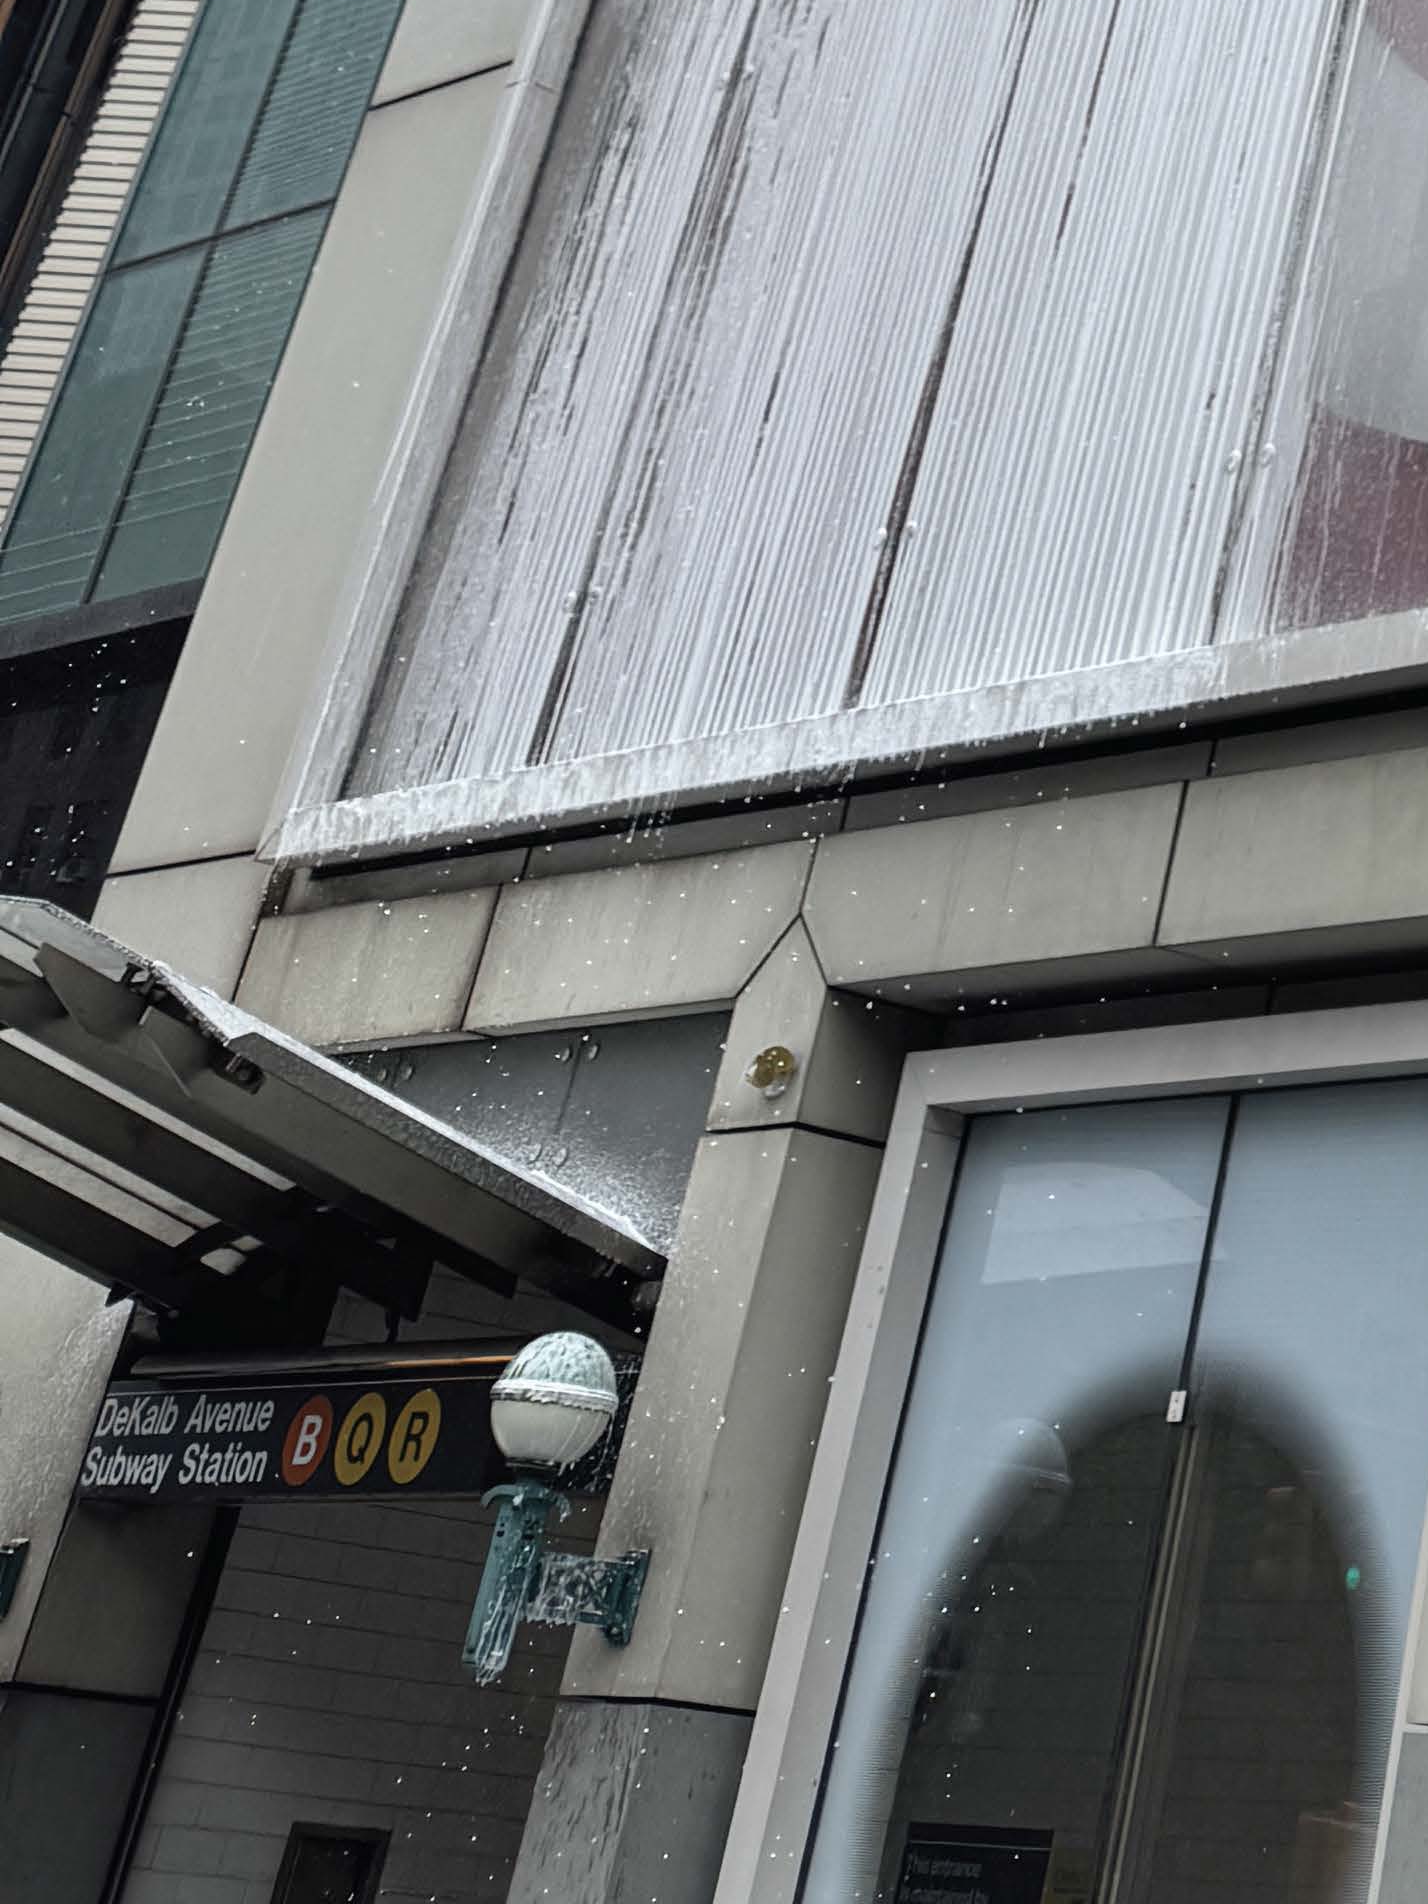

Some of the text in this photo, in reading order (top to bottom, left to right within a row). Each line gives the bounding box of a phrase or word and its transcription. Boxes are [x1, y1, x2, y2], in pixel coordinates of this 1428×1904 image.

[95, 1394, 275, 1437] DeKalb Avenue
[292, 1411, 429, 1466] B Q R
[81, 1443, 268, 1494] Subway Station
